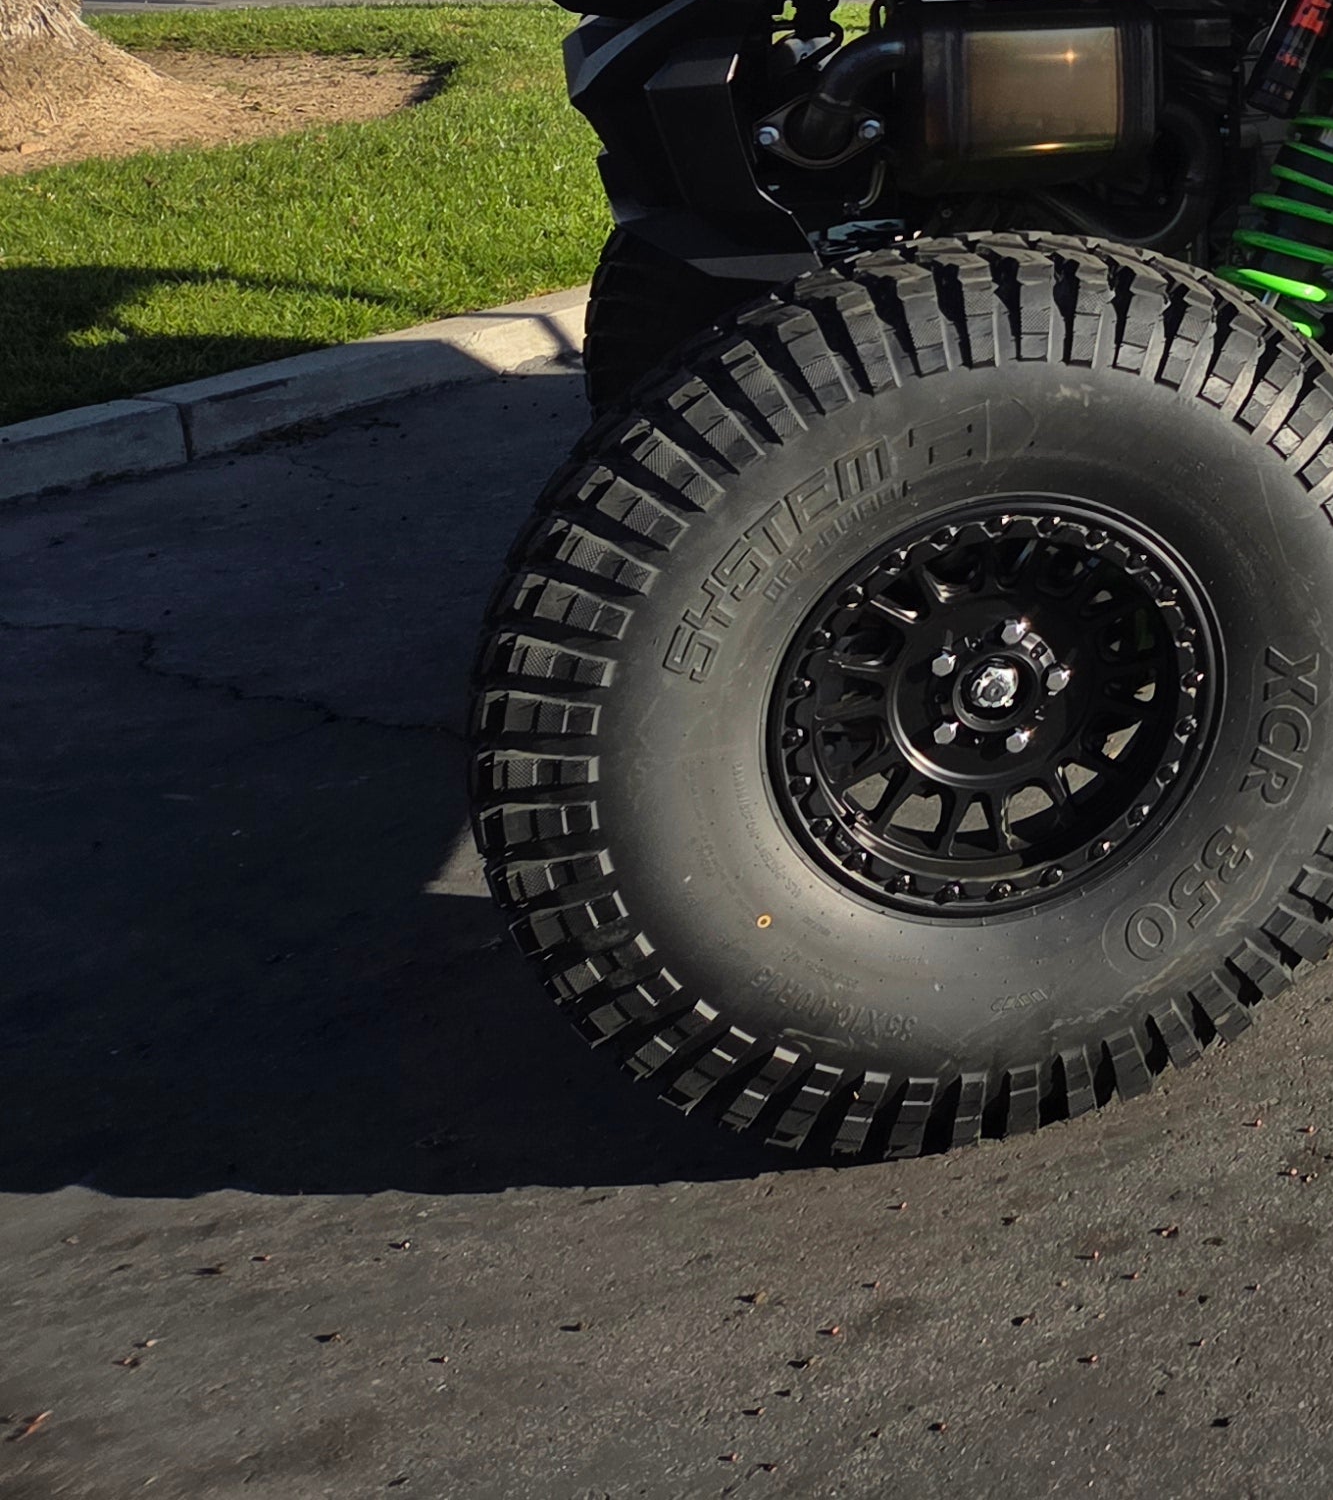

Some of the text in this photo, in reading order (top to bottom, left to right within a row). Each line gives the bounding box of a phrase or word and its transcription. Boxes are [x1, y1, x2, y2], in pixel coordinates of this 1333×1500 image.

[662, 434, 895, 684] SYSTEM
[1124, 645, 1320, 962] XCR 350
